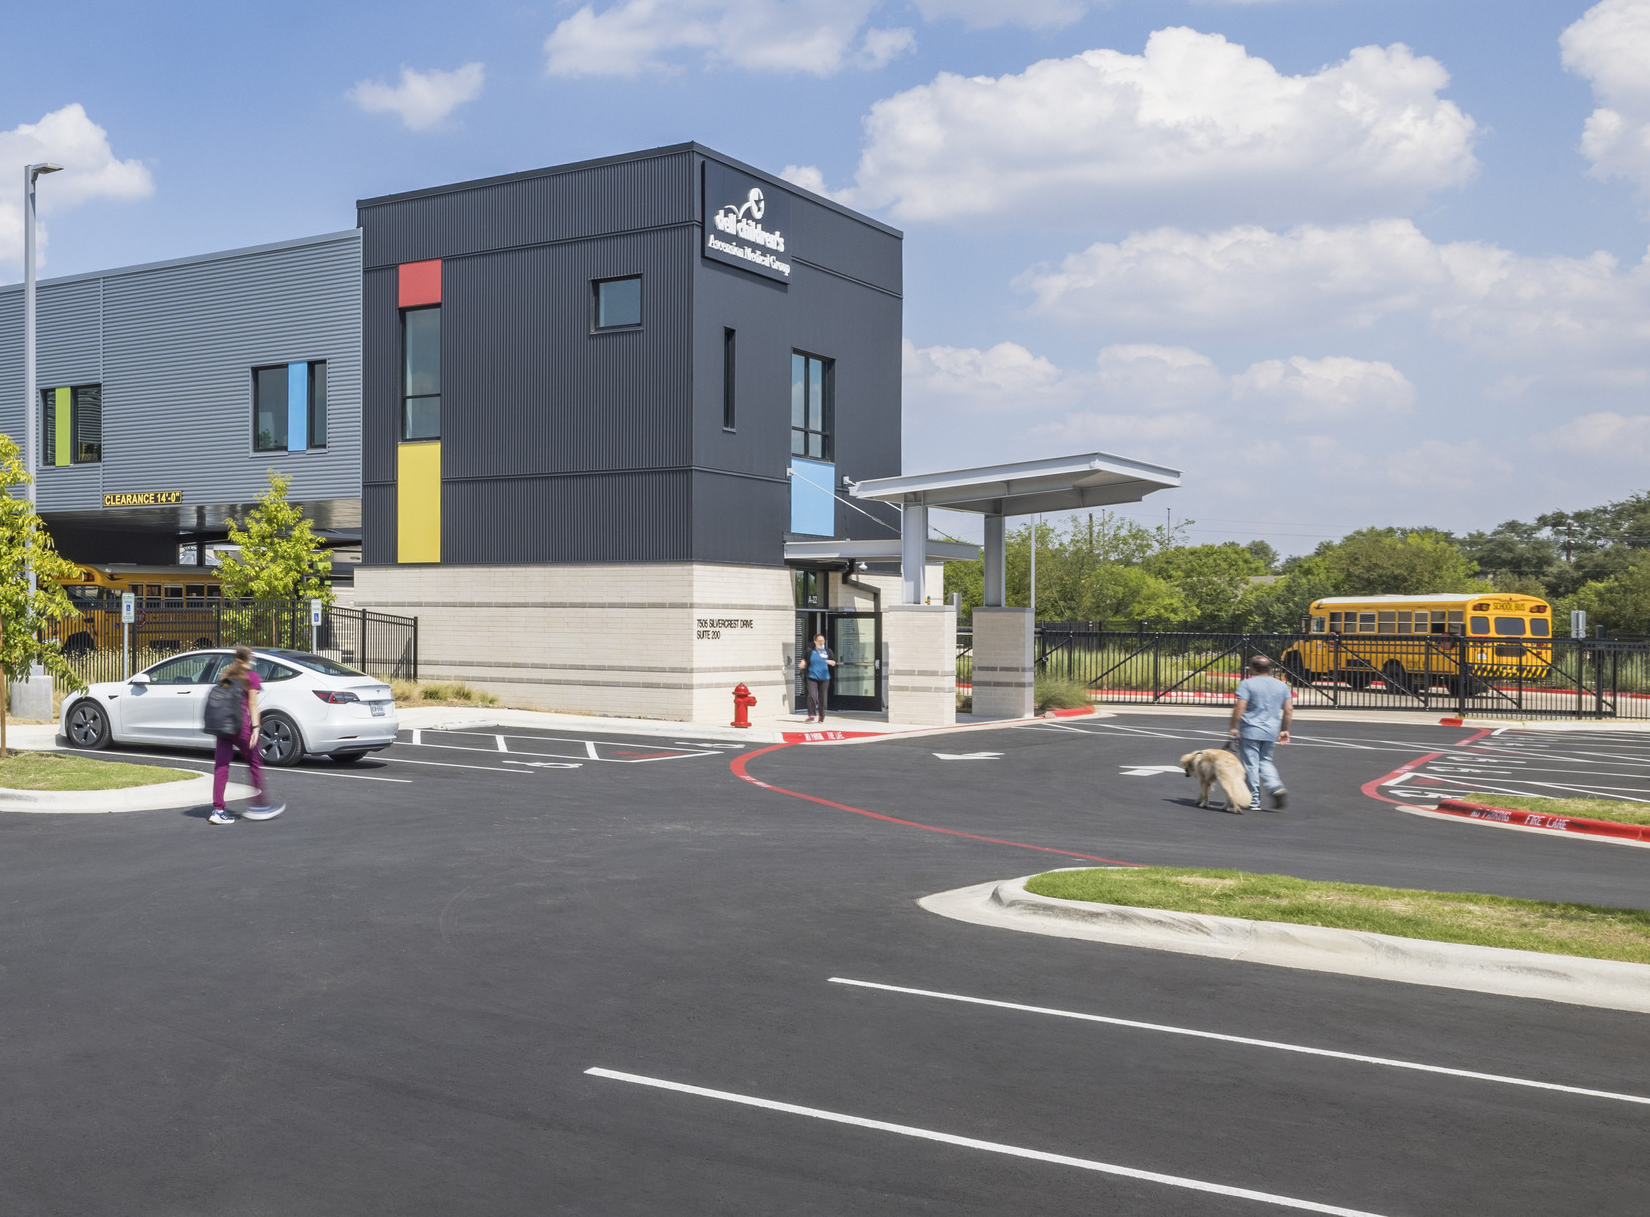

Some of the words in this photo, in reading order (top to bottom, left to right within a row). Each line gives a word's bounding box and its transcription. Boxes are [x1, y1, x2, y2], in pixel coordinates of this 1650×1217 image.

[714, 209, 737, 235] dell
[708, 234, 744, 258] Ascension
[105, 493, 155, 505] CLEARANCE
[156, 492, 179, 503] 14'-0"
[1493, 602, 1513, 611] SCHOOL
[1514, 603, 1526, 611] BUS
[708, 618, 739, 629] SILVERCREST
[739, 619, 754, 629] DRIVE
[696, 630, 711, 640] SUITE
[711, 630, 721, 640] 200
[1524, 814, 1545, 825] FIRE
[1546, 817, 1570, 830] LANE
